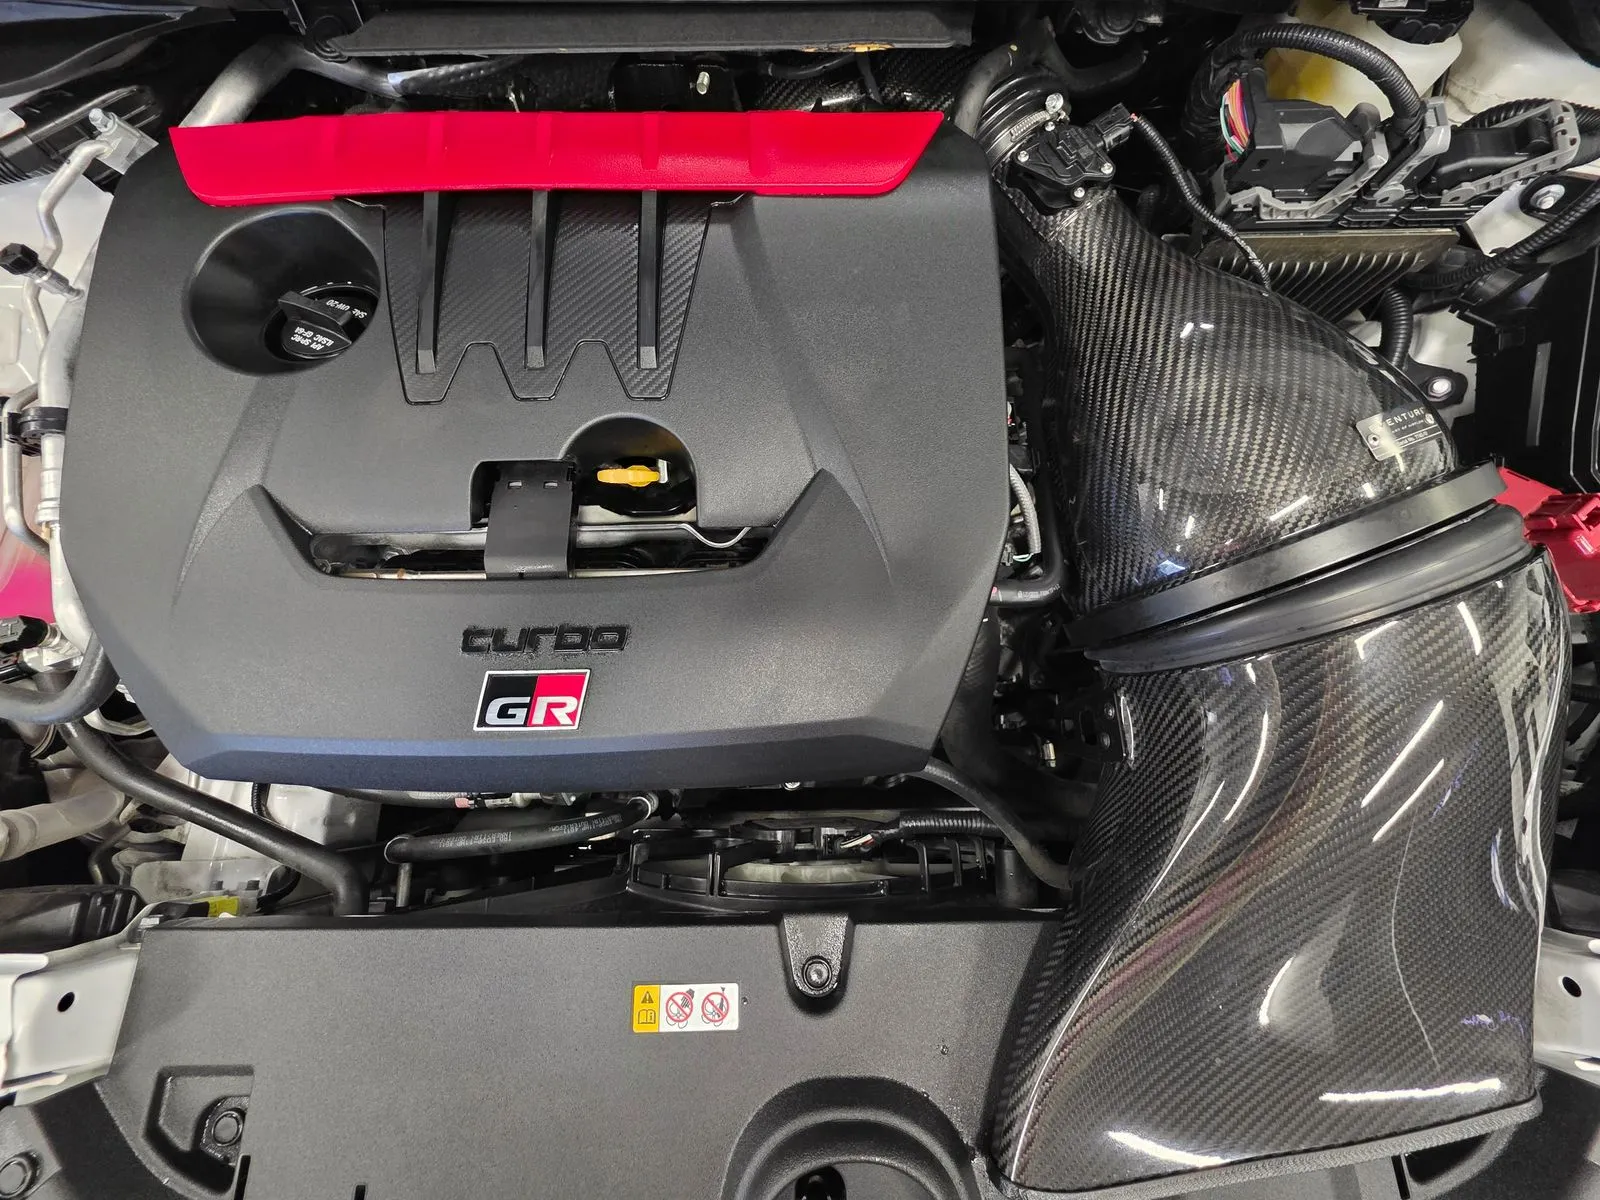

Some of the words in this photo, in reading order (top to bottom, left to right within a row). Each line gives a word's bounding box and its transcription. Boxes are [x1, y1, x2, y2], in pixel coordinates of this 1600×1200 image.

[314, 334, 334, 346] ILSAC
[461, 624, 630, 653] turbo
[485, 696, 578, 726] GR
